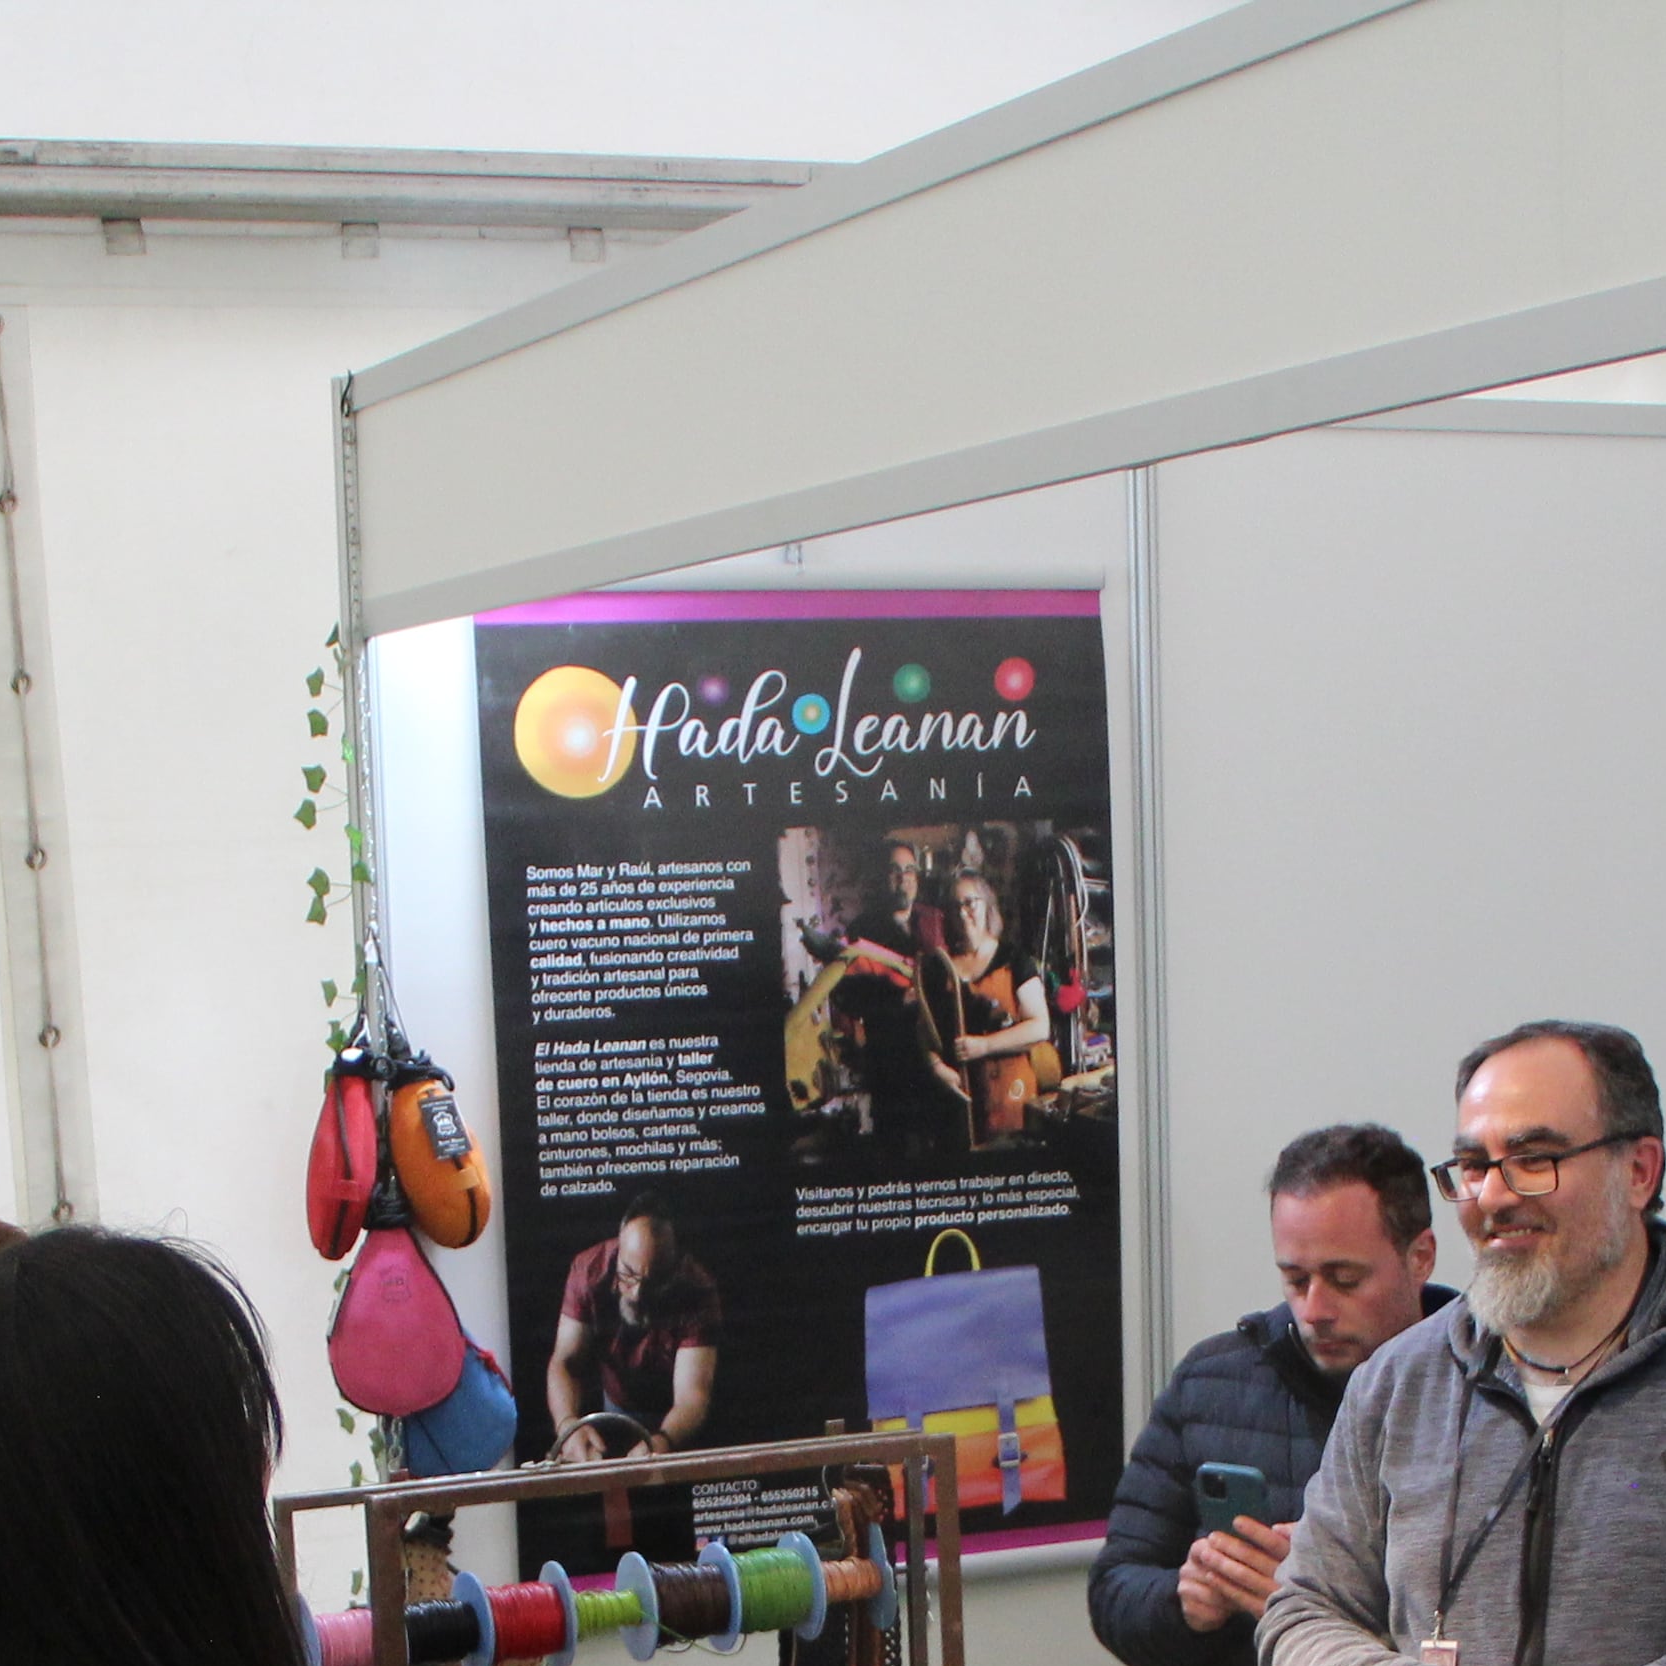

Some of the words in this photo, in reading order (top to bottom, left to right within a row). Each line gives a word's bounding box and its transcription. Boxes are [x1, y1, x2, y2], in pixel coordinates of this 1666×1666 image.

[597, 668, 801, 784] Hada
[814, 647, 1036, 777] Leanan
[642, 774, 1033, 809] ARTESANÍA
[526, 865, 574, 880] Somos
[577, 865, 603, 878] Mar
[607, 866, 615, 880] y
[658, 863, 723, 875] artesanos
[726, 860, 751, 872] con
[527, 884, 556, 898] más
[559, 882, 577, 896] de
[580, 883, 598, 896] 25
[602, 880, 634, 895] años
[638, 879, 655, 893] de
[659, 876, 734, 894] experiencia
[528, 901, 582, 915] creando
[647, 896, 716, 911] exclusivos
[529, 921, 536, 936] y
[540, 918, 593, 932] hechos
[597, 919, 606, 930] a
[609, 917, 654, 929] mano.
[658, 913, 726, 927] Utilizamos
[529, 938, 567, 950] cuero
[571, 935, 620, 948] vacuno
[624, 932, 680, 945] nacional
[683, 930, 699, 943] de
[703, 930, 754, 945] primera
[530, 954, 586, 969] calidad,
[590, 949, 663, 965] fusionando
[667, 946, 739, 961] creatividad
[531, 975, 539, 989] y
[542, 969, 600, 985] tradición
[603, 967, 665, 981] artesanal
[669, 966, 699, 982] para
[532, 988, 591, 1004] ofrecerte
[595, 985, 661, 1002] productos
[665, 983, 708, 996] únicos
[533, 1010, 540, 1024] y
[544, 1005, 615, 1020] duraderos.
[535, 1042, 549, 1056] El
[553, 1041, 590, 1055] Hada
[594, 1039, 646, 1053] Leanan
[649, 1040, 665, 1050] es
[669, 1035, 719, 1048] nuestra
[535, 1060, 575, 1073] tienda
[579, 1058, 597, 1071] de
[666, 1056, 674, 1070] y
[678, 1052, 714, 1065] taller
[536, 1078, 554, 1091] de
[557, 1078, 598, 1089] cuero
[602, 1076, 619, 1087] en
[537, 1095, 550, 1109] El
[554, 1092, 607, 1107] corazón
[611, 1091, 628, 1104] de
[631, 1090, 643, 1103] la
[647, 1087, 688, 1101] tienda
[692, 1088, 707, 1099] es
[711, 1084, 760, 1098] nuestro
[537, 1112, 573, 1126] taller,
[577, 1109, 619, 1123] donde
[623, 1105, 694, 1121] diseñamos
[698, 1107, 705, 1120] y
[709, 1102, 765, 1115] creamos
[538, 1134, 546, 1144] a
[551, 1130, 588, 1142] mano
[592, 1127, 638, 1140] bolsos,
[539, 1148, 611, 1162] cinturones,
[616, 1141, 674, 1157] mochilas
[678, 1142, 686, 1155] y
[540, 1164, 592, 1178] también
[597, 1159, 666, 1174] ofrecemos
[670, 1154, 739, 1171] reparación
[541, 1183, 557, 1197] de
[561, 1180, 616, 1195] calzado.
[857, 1187, 864, 1201] y
[868, 1181, 911, 1199] podrás
[915, 1180, 956, 1192] vernos
[960, 1175, 1005, 1190] trabajar
[1009, 1176, 1023, 1185] en
[796, 1202, 854, 1218] descubrir
[858, 1199, 912, 1214] nuestras
[916, 1196, 966, 1210] técnicas
[983, 1192, 993, 1204] lo
[997, 1191, 1022, 1202] más
[797, 1218, 852, 1236] encargar
[856, 1218, 868, 1230] tu
[872, 1215, 911, 1231] propio
[915, 1212, 974, 1228] producto
[978, 1203, 1071, 1223] personalizado.
